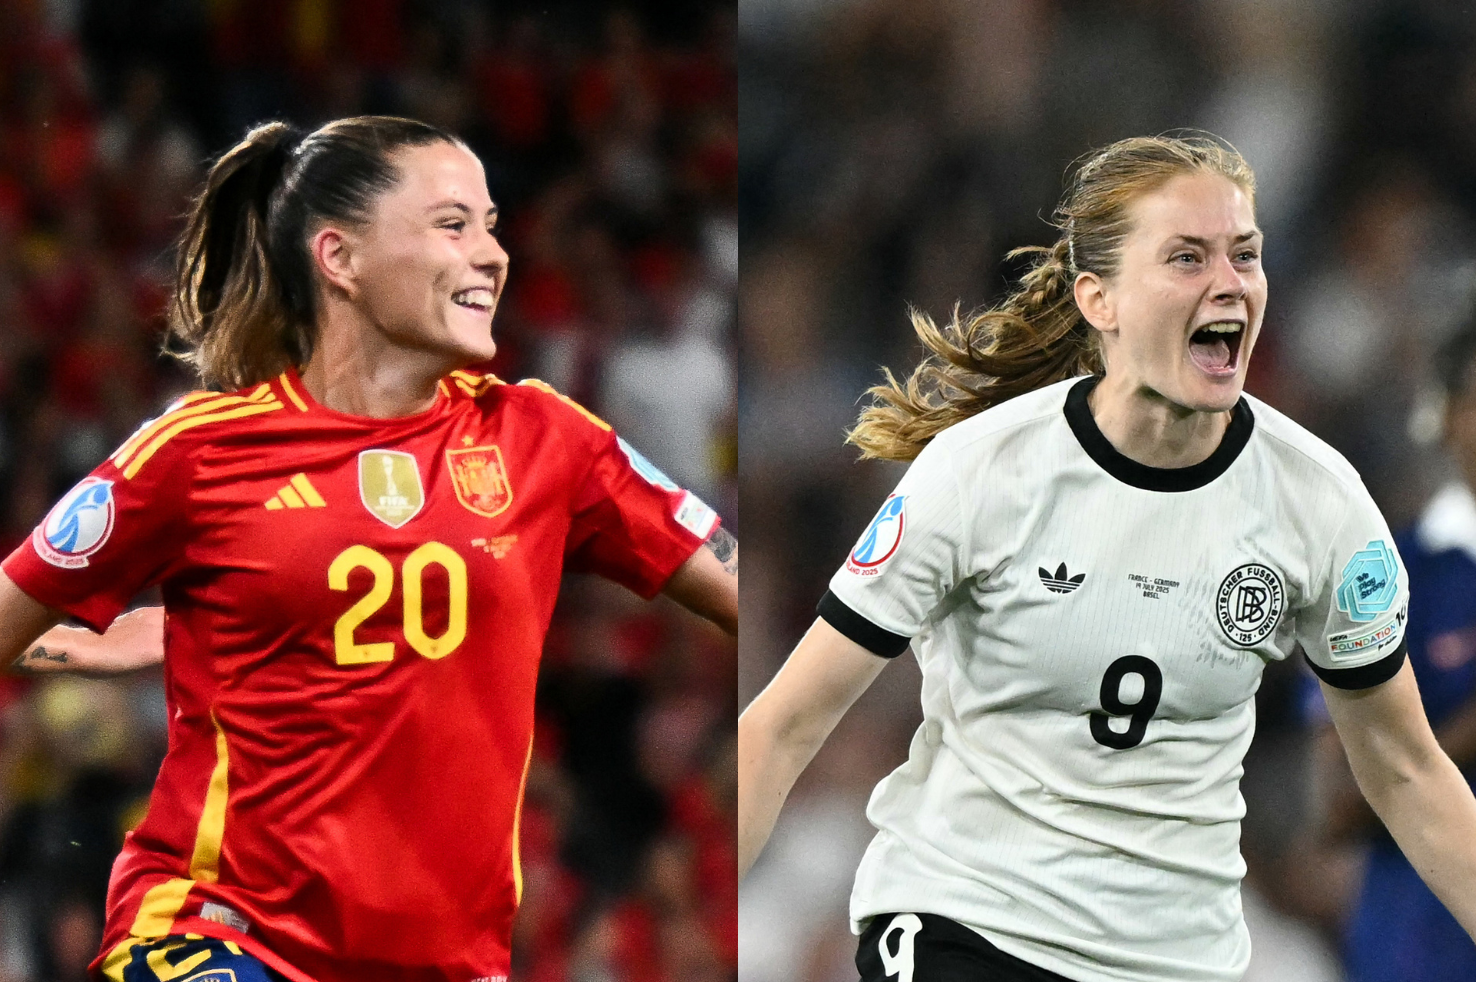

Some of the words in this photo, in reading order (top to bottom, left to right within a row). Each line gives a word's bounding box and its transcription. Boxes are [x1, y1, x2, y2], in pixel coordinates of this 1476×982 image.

[379, 496, 408, 506] FIFA
[1128, 574, 1148, 582] FRANCE
[1154, 578, 1180, 588] GERMANY
[1360, 579, 1386, 600] Strong
[1143, 591, 1160, 600] BASEL
[1156, 586, 1170, 594] 2025
[328, 541, 468, 666] 20
[1331, 625, 1396, 651] FOUNDATION
[1090, 655, 1163, 750] 9
